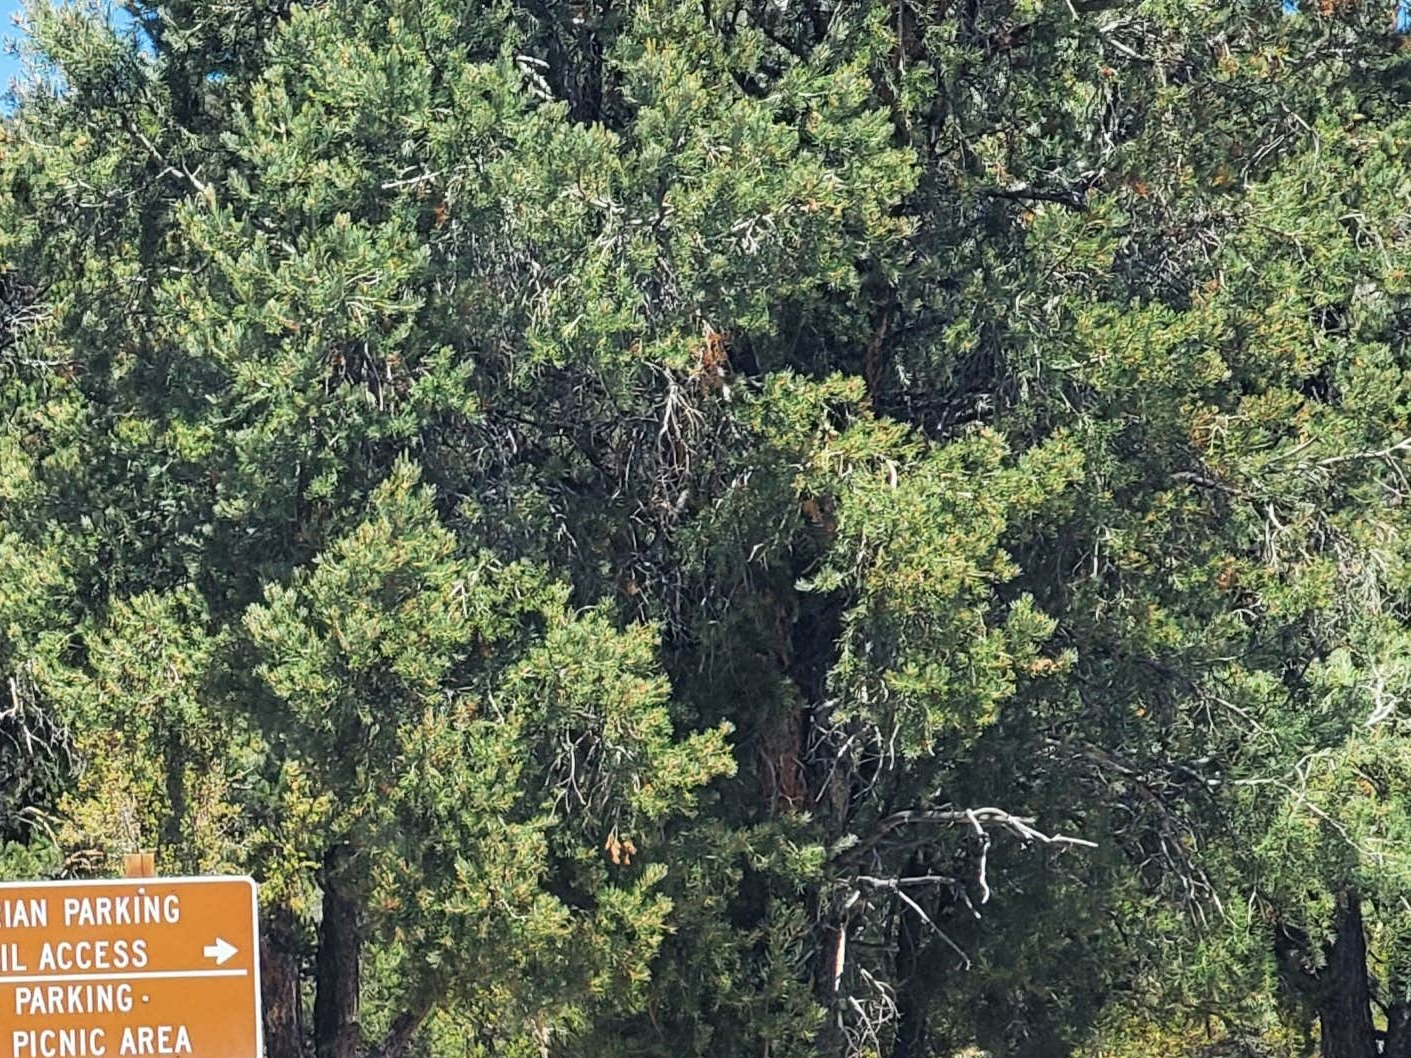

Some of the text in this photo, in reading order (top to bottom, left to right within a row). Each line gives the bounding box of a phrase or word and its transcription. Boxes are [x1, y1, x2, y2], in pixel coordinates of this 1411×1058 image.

[64, 895, 181, 925] PARKING
[39, 939, 148, 970] ACCESS
[16, 984, 133, 1015] PARKING
[13, 1029, 106, 1058] PICNIC
[120, 1025, 192, 1055] AREA
